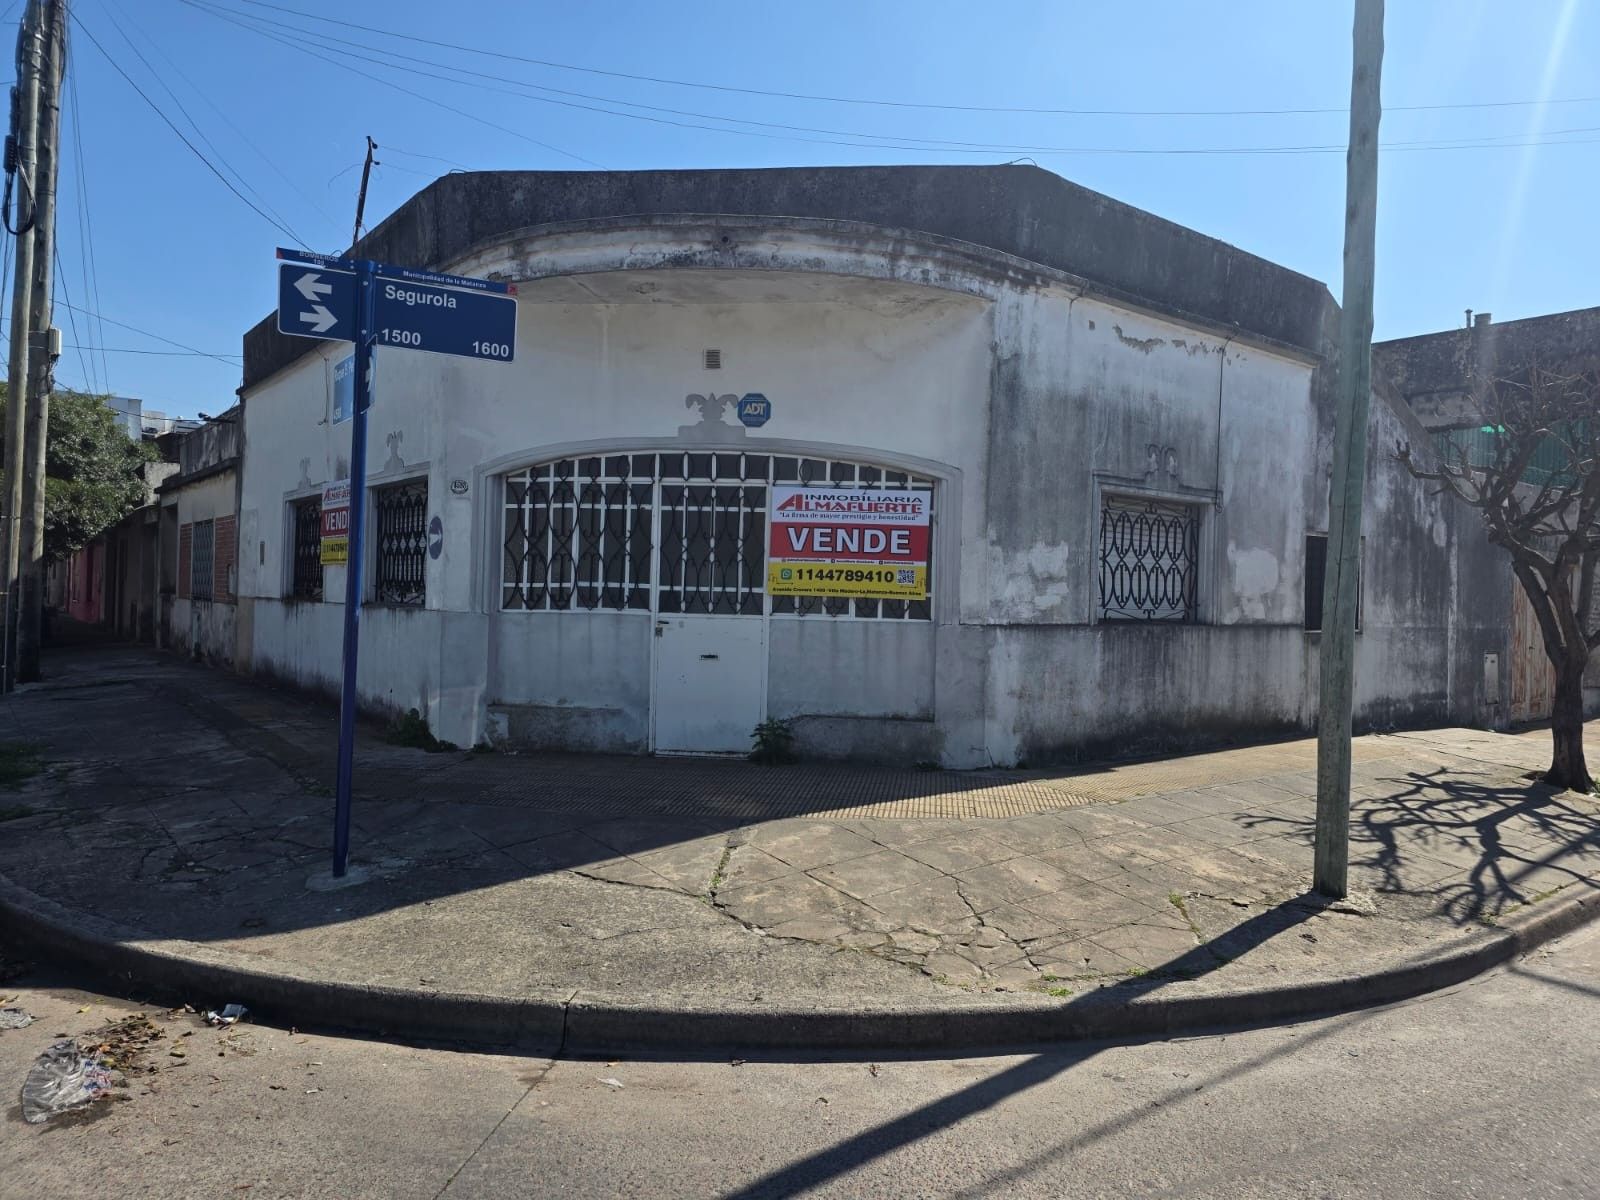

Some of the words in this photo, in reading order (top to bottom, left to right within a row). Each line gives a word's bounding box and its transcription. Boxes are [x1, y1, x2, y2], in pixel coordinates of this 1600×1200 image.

[403, 270, 445, 284] Municipalidad
[461, 279, 487, 288] Matanza
[385, 285, 457, 309] Segurola
[382, 328, 421, 345] 1500
[472, 341, 509, 357] 1600
[743, 402, 767, 416] ADT
[776, 494, 922, 514] ALMAFUERTE
[805, 494, 922, 503] INMOBILIARIA
[787, 527, 911, 554] VENDE
[796, 568, 894, 582] 1144789410
